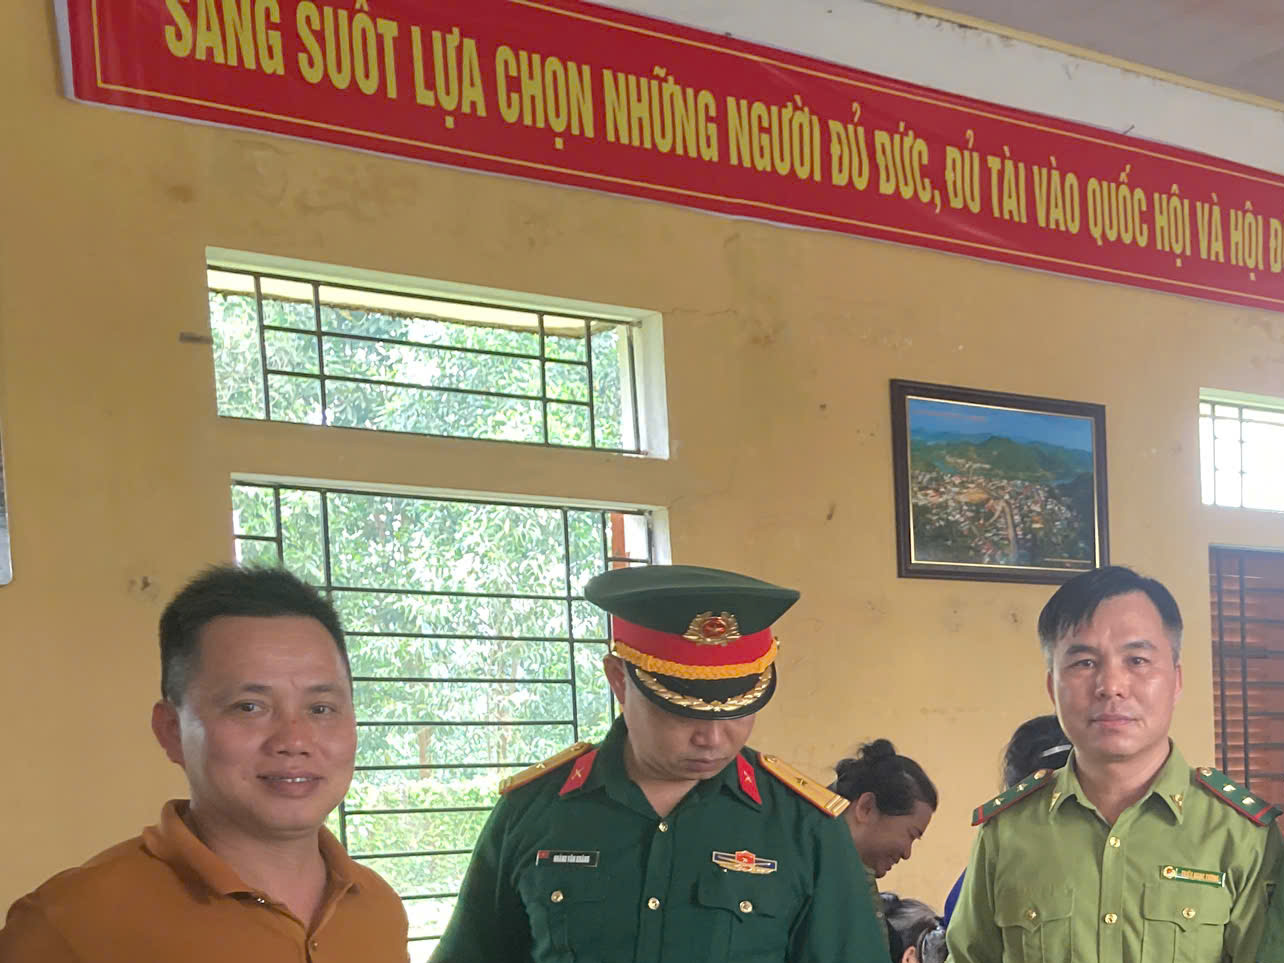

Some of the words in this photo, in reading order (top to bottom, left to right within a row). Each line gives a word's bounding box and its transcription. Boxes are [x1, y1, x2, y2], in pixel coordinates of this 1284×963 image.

[411, 26, 486, 129] LỰA
[496, 46, 594, 149] CHỌN
[603, 65, 718, 161] NHỮNG
[727, 95, 821, 182] NGƯỜI
[829, 102, 869, 191] ĐỦ
[875, 121, 942, 213] ĐỨC,
[945, 130, 980, 214] ĐỦ
[987, 145, 1026, 224] TÀI
[1033, 155, 1080, 235] VÀO
[1088, 165, 1148, 247] QUỐC
[1154, 184, 1191, 268] HỘI
[1196, 193, 1224, 264] VÀ
[1230, 201, 1264, 281] HỘI
